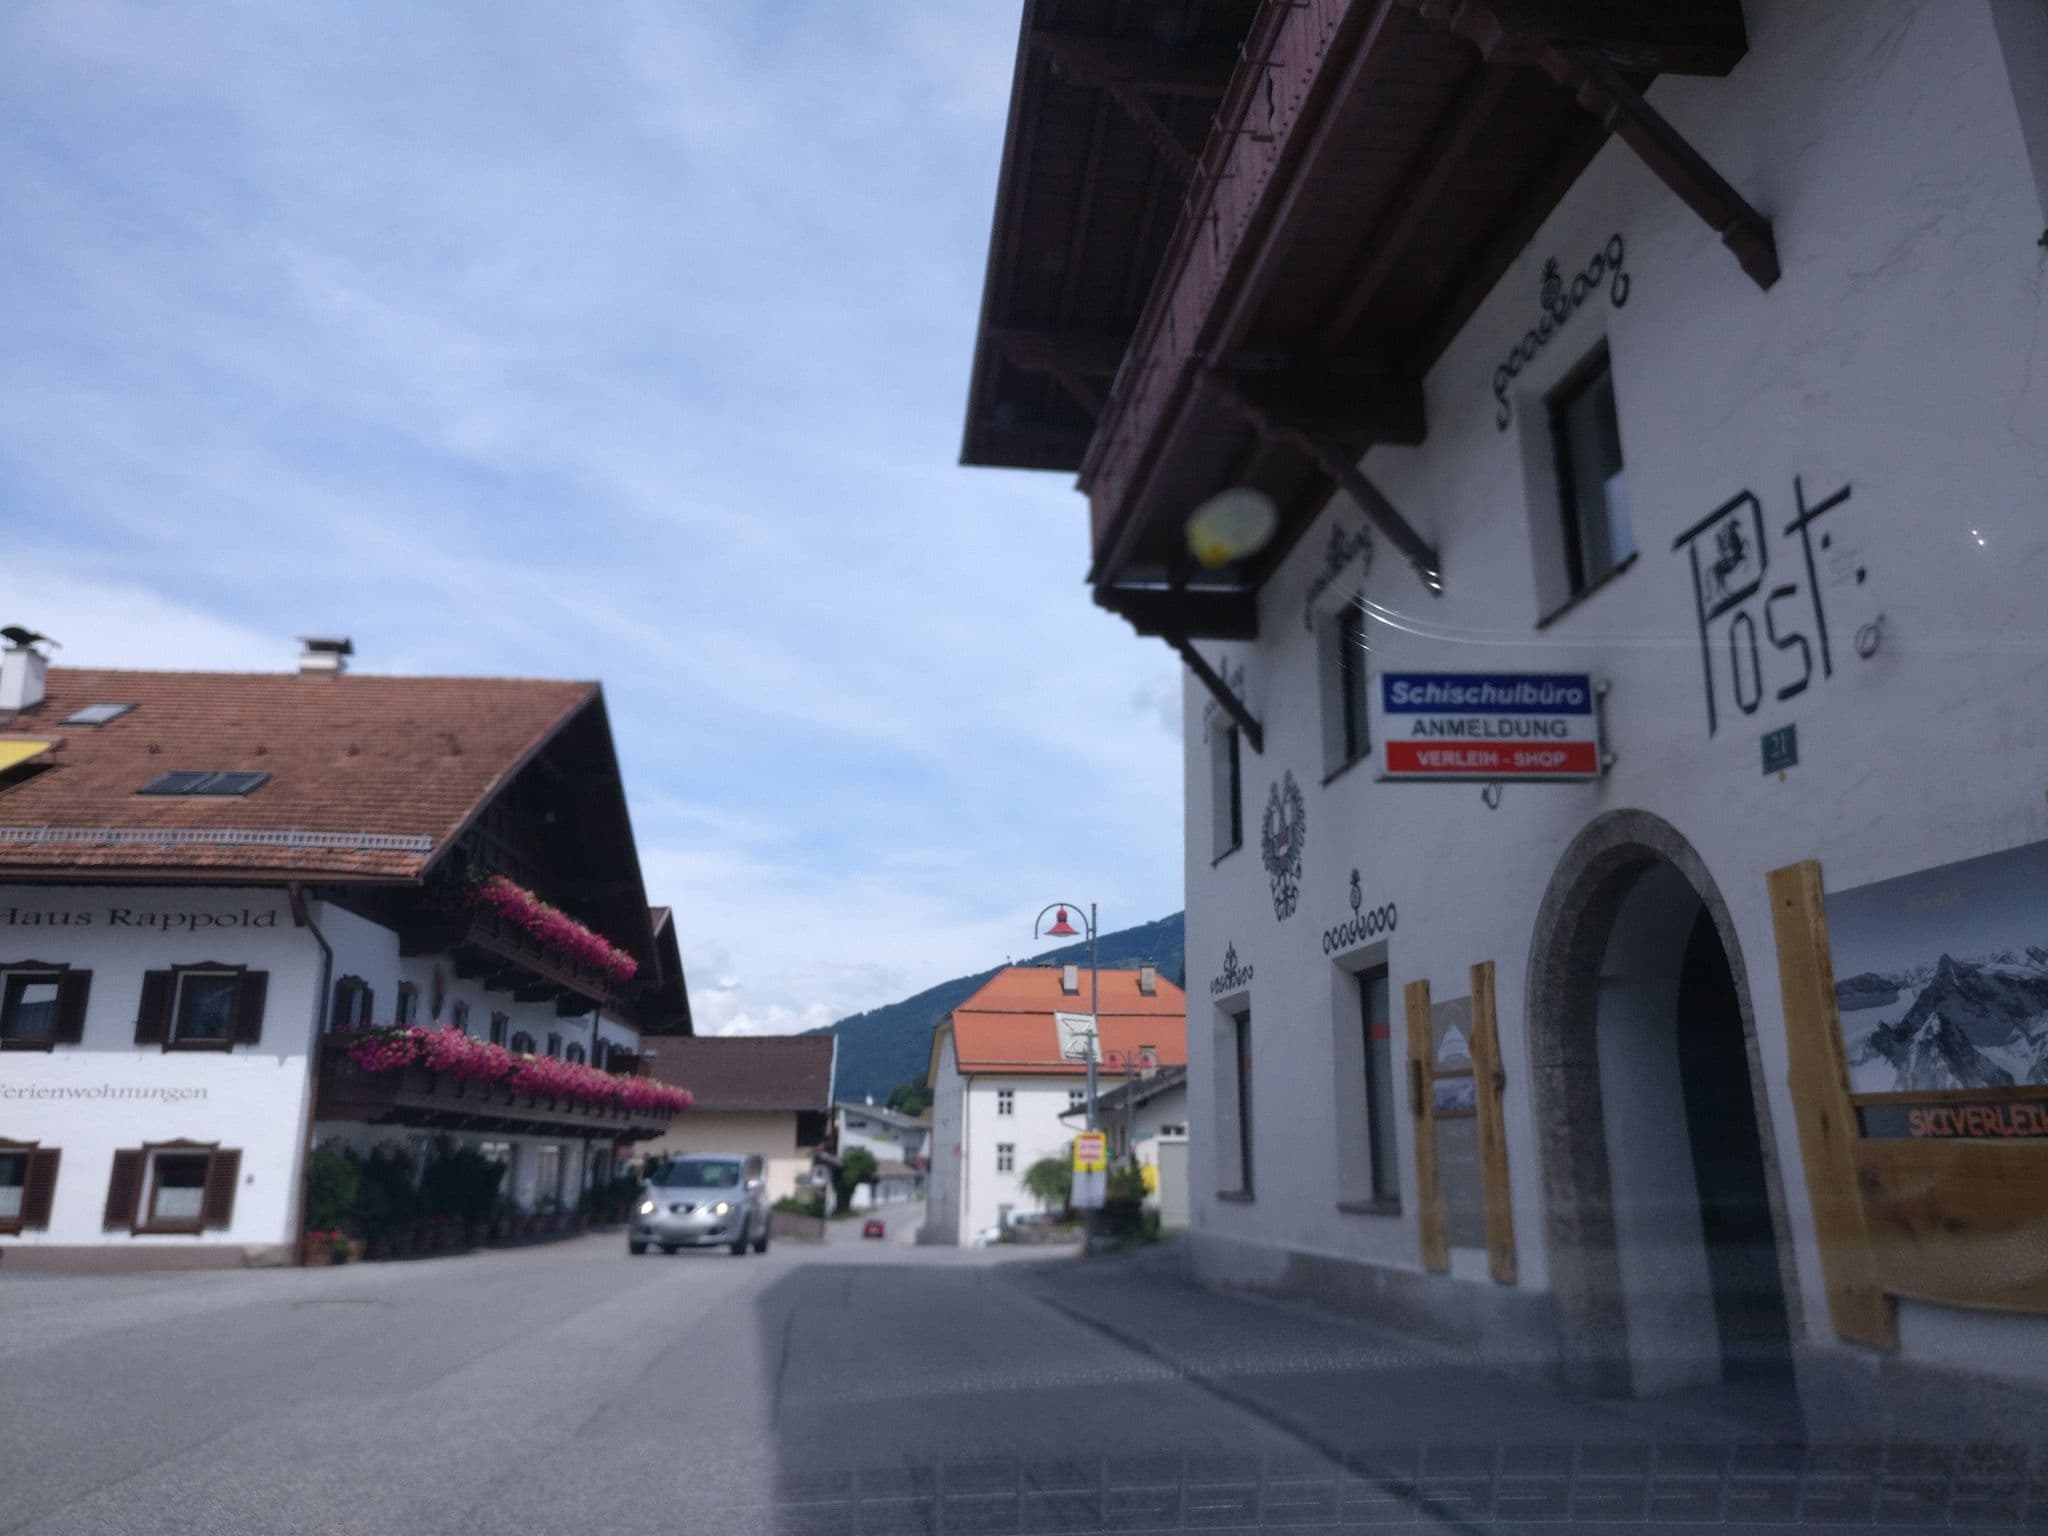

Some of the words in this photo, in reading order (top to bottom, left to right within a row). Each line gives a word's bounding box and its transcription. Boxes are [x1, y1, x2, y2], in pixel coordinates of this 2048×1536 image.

[1391, 681, 1584, 706] Schischulbüro
[1412, 718, 1568, 738] ANMELDUNG
[1416, 750, 1497, 767] VERLEIH
[1514, 750, 1567, 767] SHOP
[108, 906, 279, 931] Rappold
